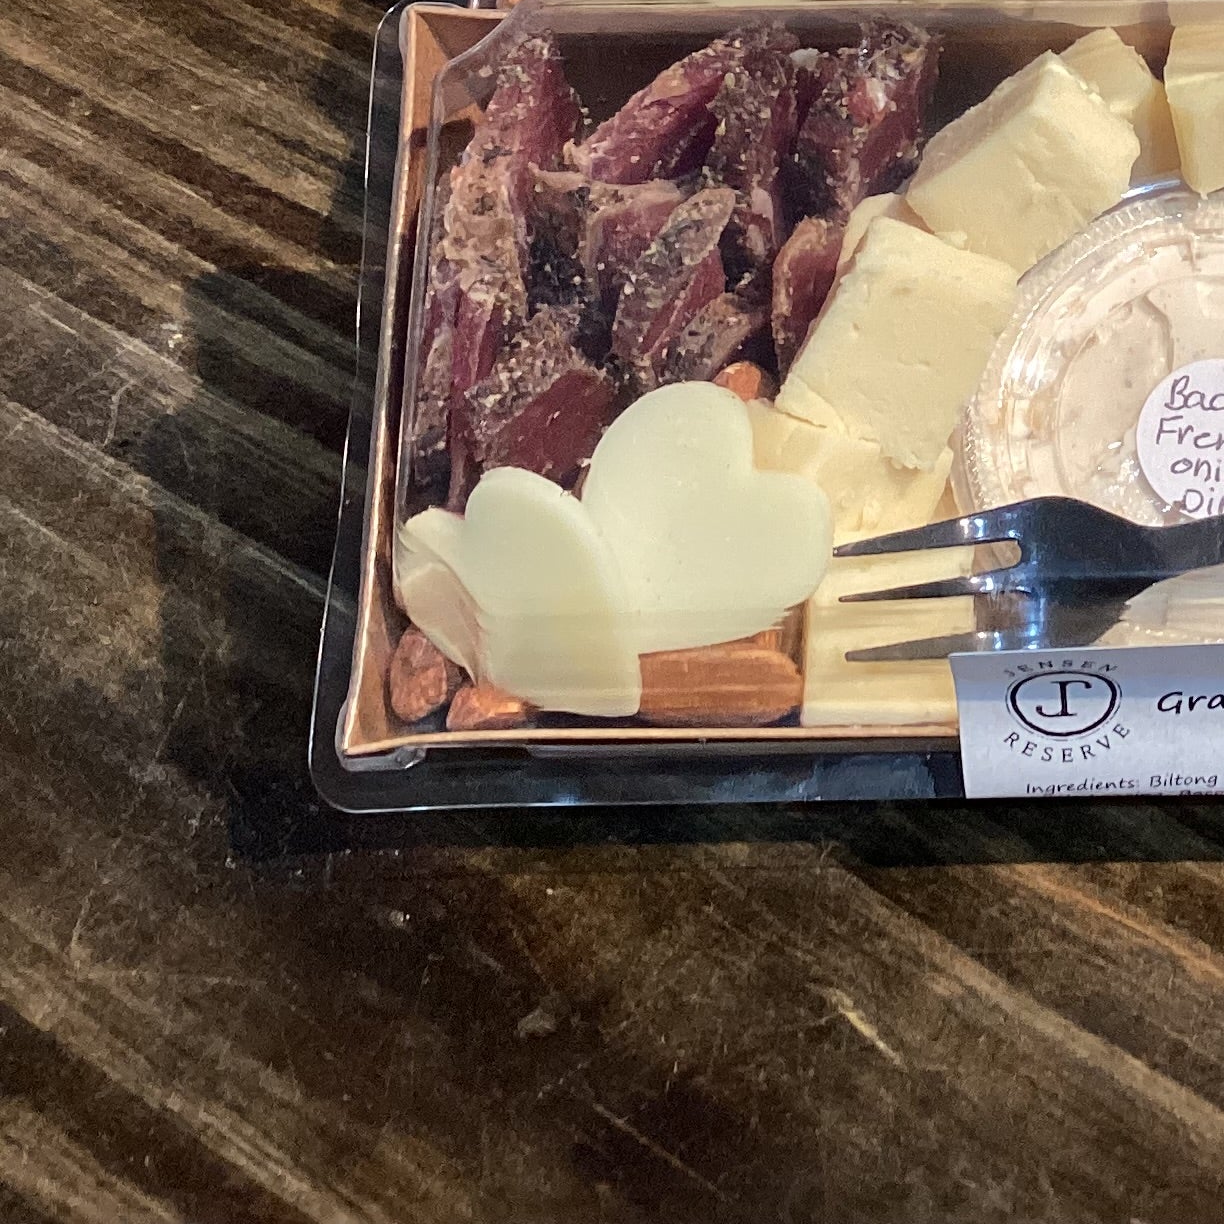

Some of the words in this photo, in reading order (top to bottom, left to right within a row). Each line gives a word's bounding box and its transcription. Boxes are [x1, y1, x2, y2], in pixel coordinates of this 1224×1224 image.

[1004, 657, 1119, 678] JENSEN
[1003, 722, 1132, 764] RESERVE
[1149, 772, 1218, 788] Biltong
